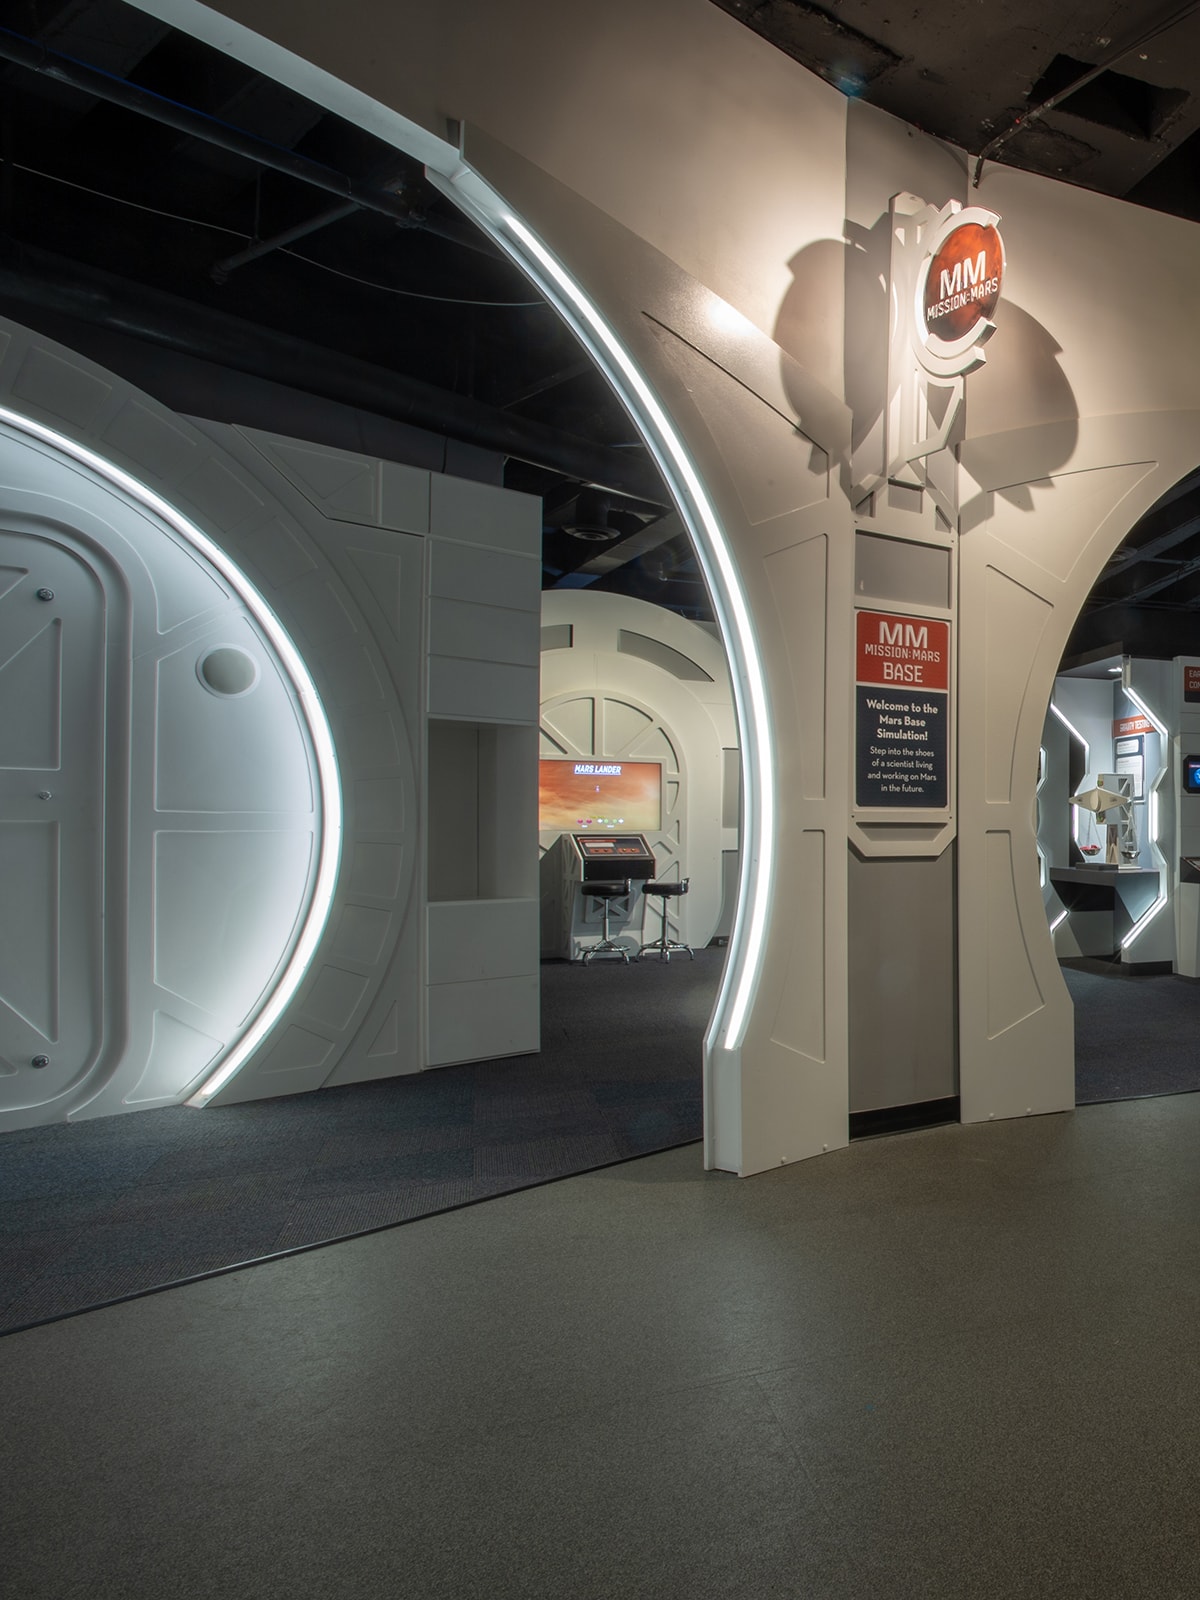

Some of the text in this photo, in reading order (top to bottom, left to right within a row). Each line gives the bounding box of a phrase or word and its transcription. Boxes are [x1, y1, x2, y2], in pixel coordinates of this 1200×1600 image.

[940, 250, 986, 300] MM
[879, 621, 928, 649] MM
[883, 662, 923, 683] BASE
[866, 698, 938, 714] Welcome to the
[880, 714, 926, 727] Mars Base
[877, 728, 928, 741] Simulation!
[870, 746, 934, 757] Step into the shoes
[595, 765, 622, 774] LANDER
[886, 760, 914, 768] scientist
[916, 761, 933, 771] living
[868, 771, 881, 780] and
[882, 772, 909, 782] working
[920, 773, 937, 781] Mars
[881, 784, 924, 792] in the future.
